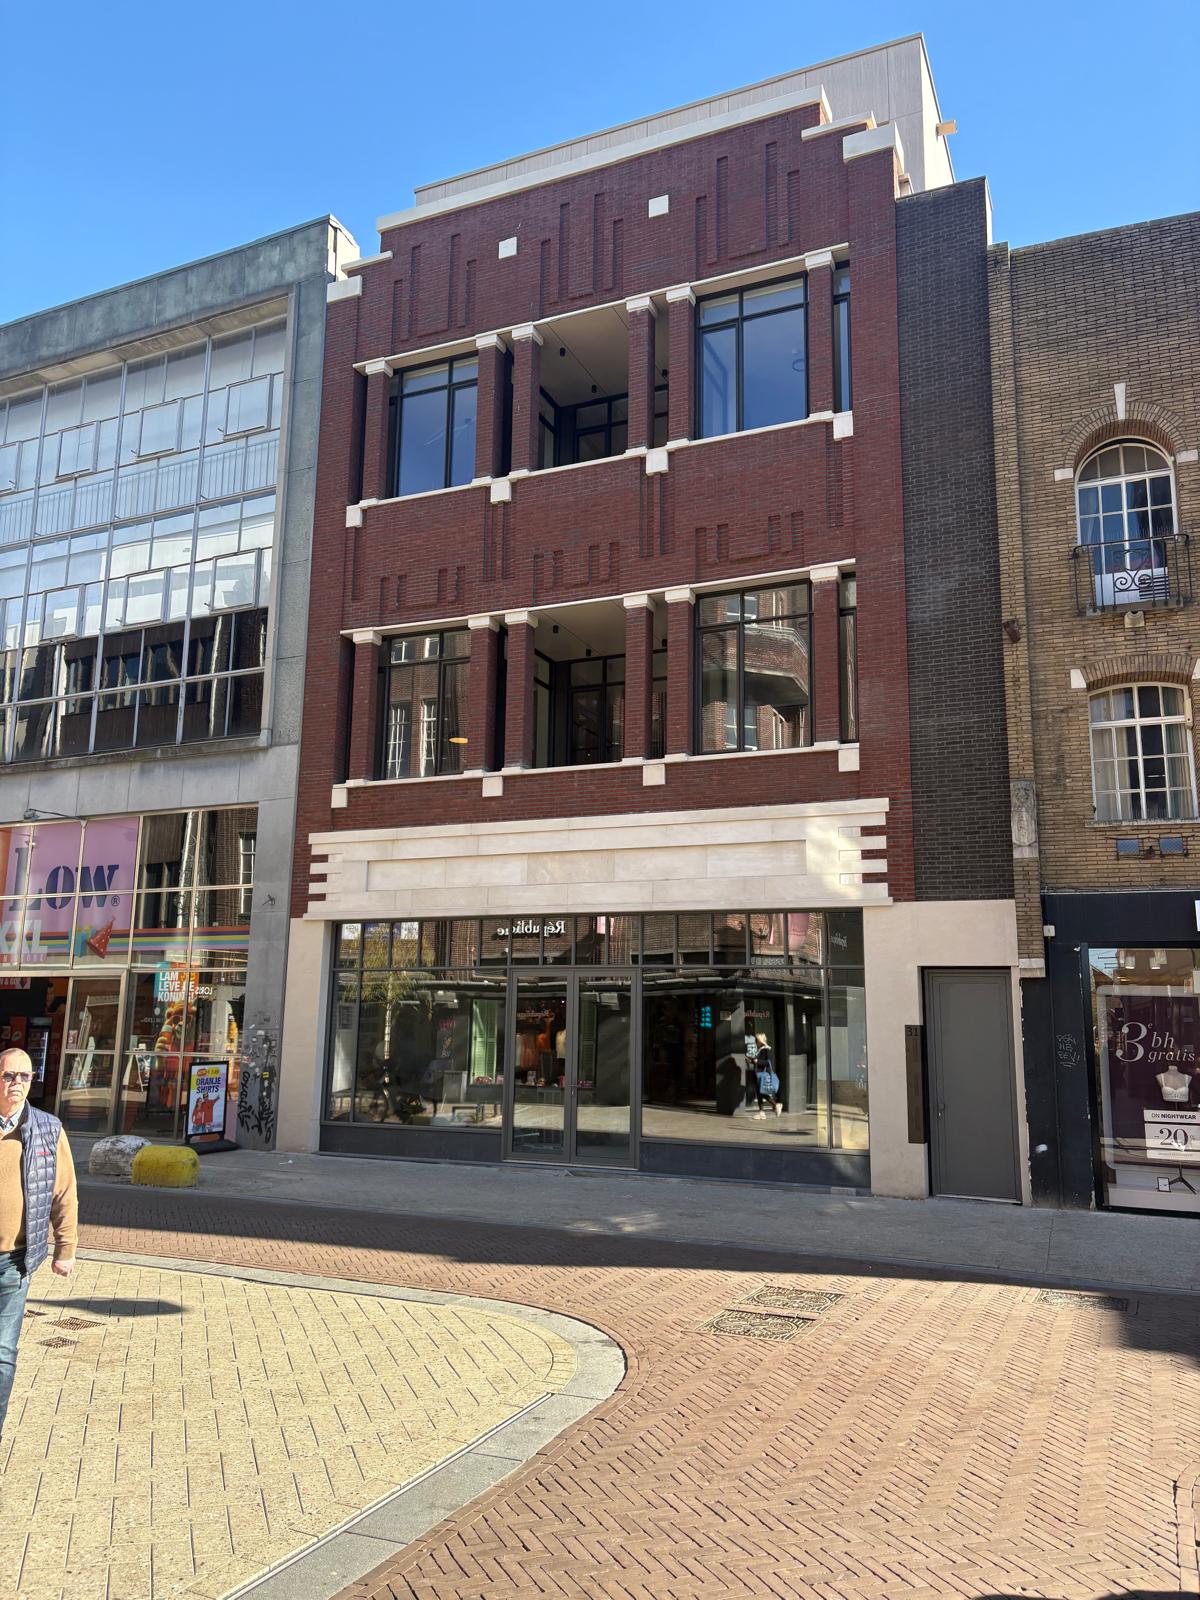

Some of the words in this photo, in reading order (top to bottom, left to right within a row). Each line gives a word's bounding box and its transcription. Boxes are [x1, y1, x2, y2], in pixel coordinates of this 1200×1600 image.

[159, 981, 180, 991] LEVE
[906, 1026, 918, 1036] 31
[1152, 1032, 1175, 1049] bh
[1147, 1049, 1196, 1063] gratis
[196, 1077, 221, 1086] ORANJE
[196, 1085, 220, 1094] SHIRTS
